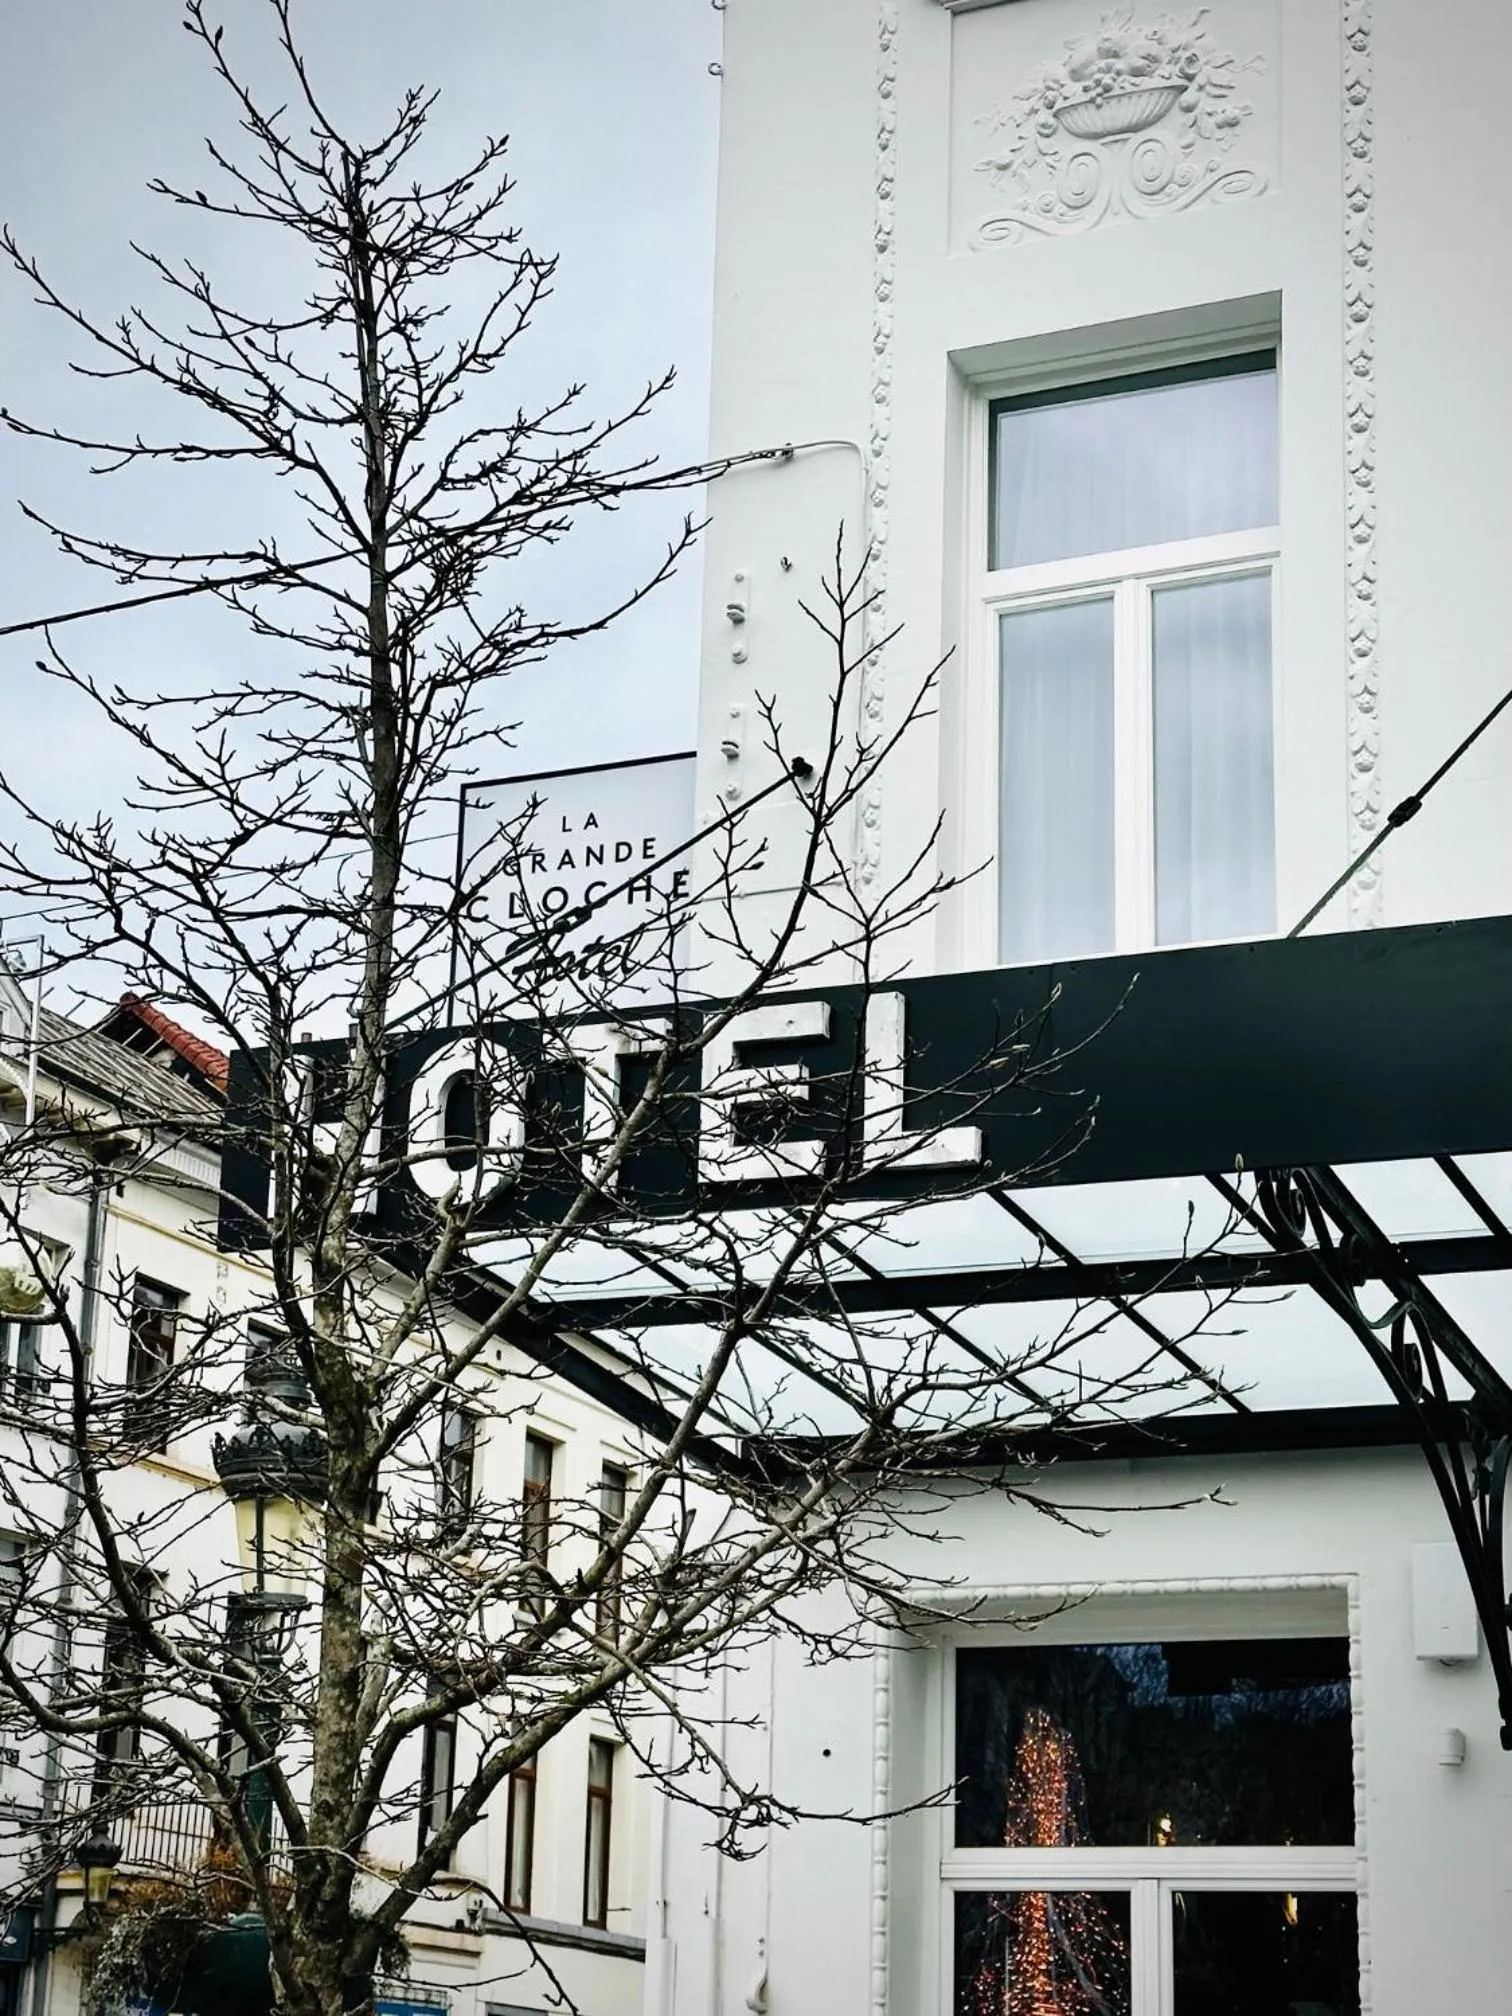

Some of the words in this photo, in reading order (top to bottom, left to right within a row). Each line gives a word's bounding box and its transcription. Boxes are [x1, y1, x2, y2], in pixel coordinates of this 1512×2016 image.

[562, 812, 599, 832] LA
[503, 838, 656, 875] GRANDE
[466, 870, 689, 922] CLOCHE
